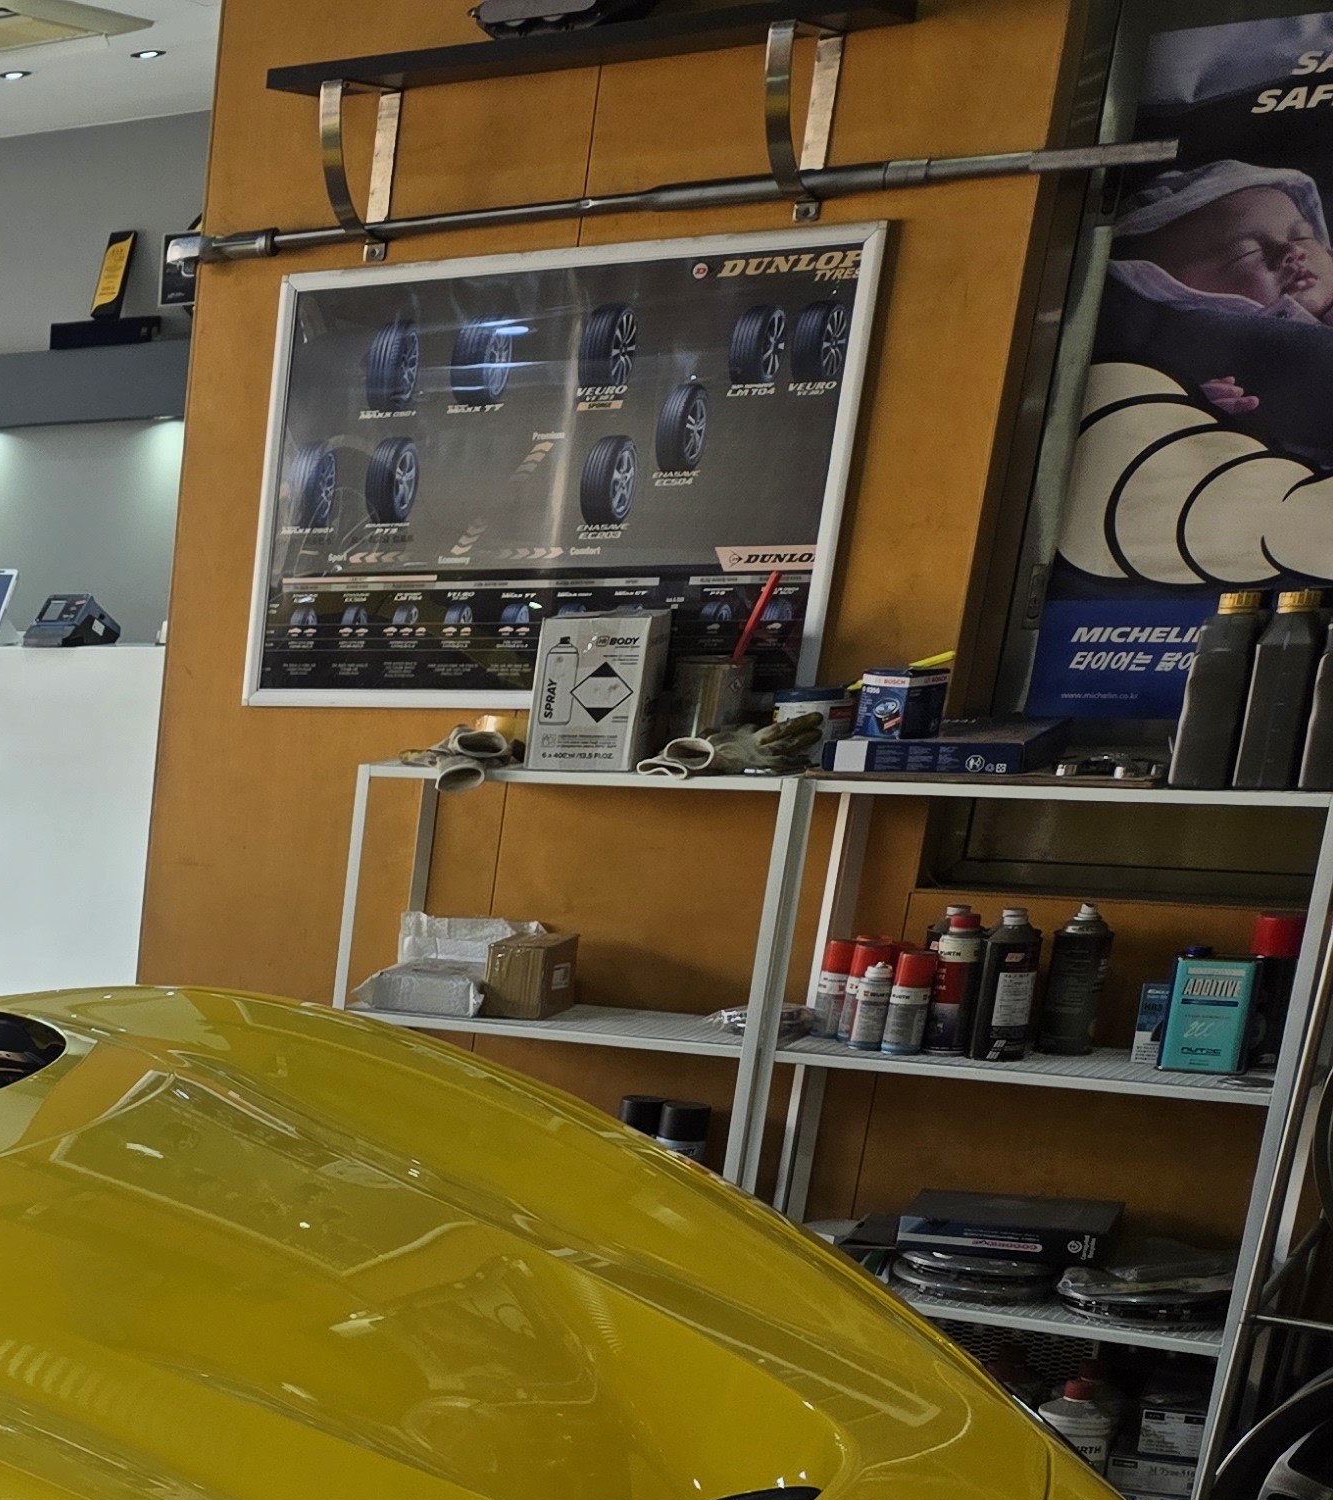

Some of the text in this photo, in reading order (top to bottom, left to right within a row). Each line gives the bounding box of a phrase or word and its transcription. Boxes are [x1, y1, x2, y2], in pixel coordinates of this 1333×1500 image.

[1251, 84, 1333, 113] SAF
[577, 385, 628, 397] VEURO
[788, 381, 837, 392] VEURO
[744, 551, 816, 564] DUNLO
[609, 636, 640, 646] BODY
[1068, 651, 1154, 672] 타이어는
[543, 678, 558, 719] SPRAY
[1183, 978, 1242, 998] ADDITIVE
[1077, 1445, 1102, 1454] RTH
